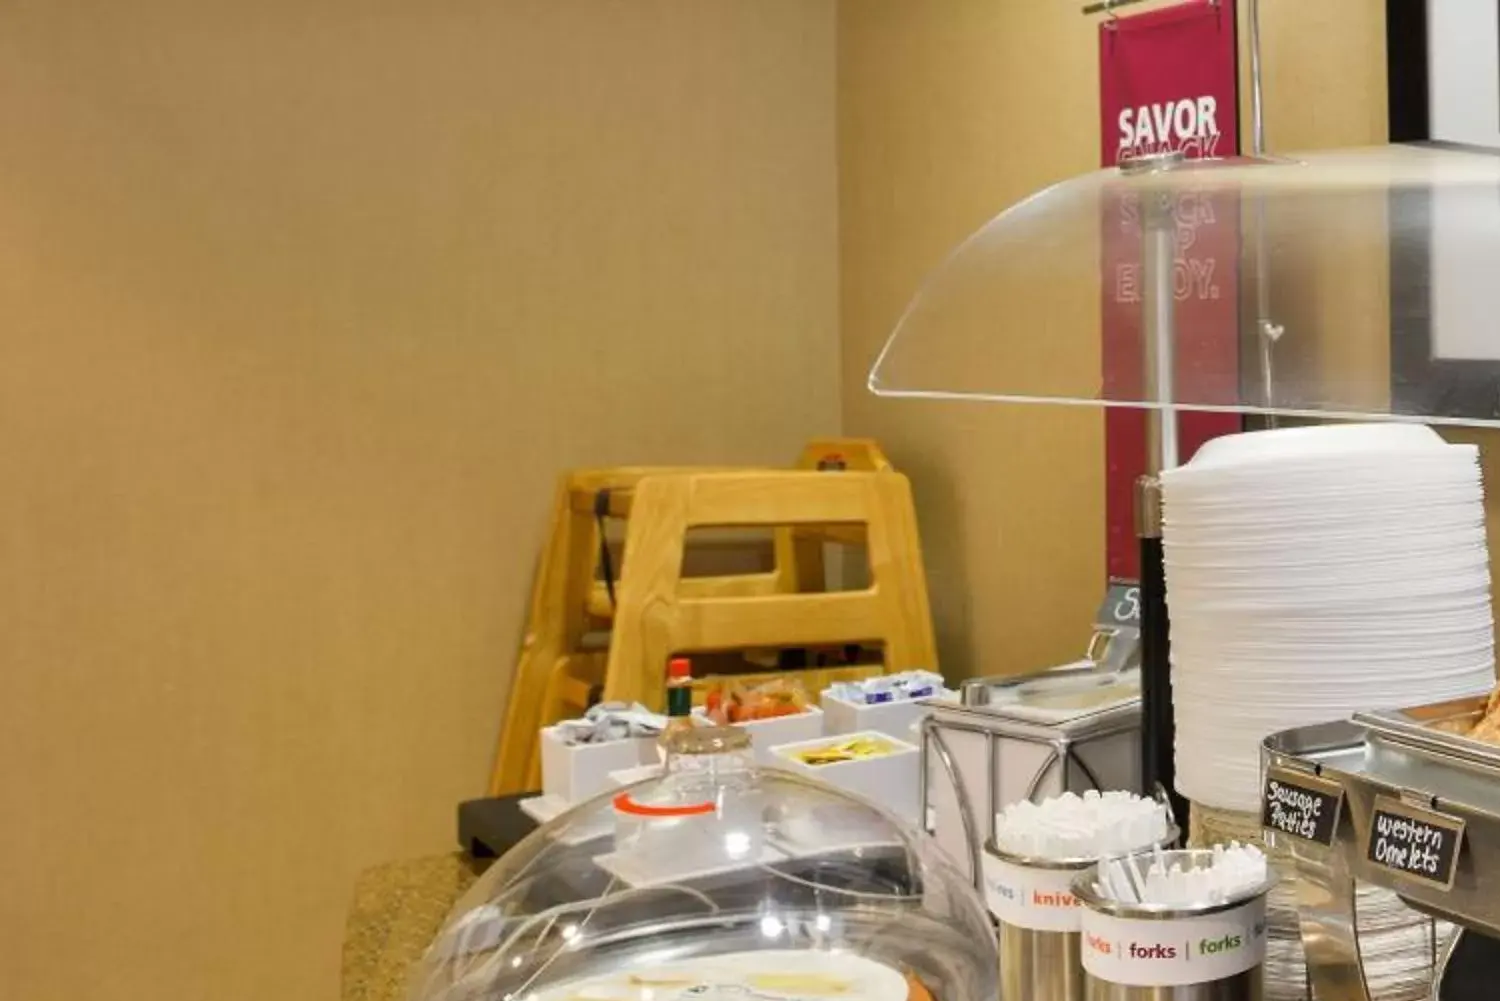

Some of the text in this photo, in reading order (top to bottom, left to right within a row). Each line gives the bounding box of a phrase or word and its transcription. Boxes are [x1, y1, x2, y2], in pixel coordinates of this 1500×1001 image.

[1118, 95, 1218, 147] SAVOR
[1116, 258, 1220, 304] EOY.
[1267, 781, 1323, 817] Sausage
[1269, 802, 1318, 840] Patties
[1375, 839, 1440, 873] Omelets
[1033, 889, 1083, 907] knive
[1129, 942, 1177, 960] forks
[1199, 934, 1241, 955] forks
